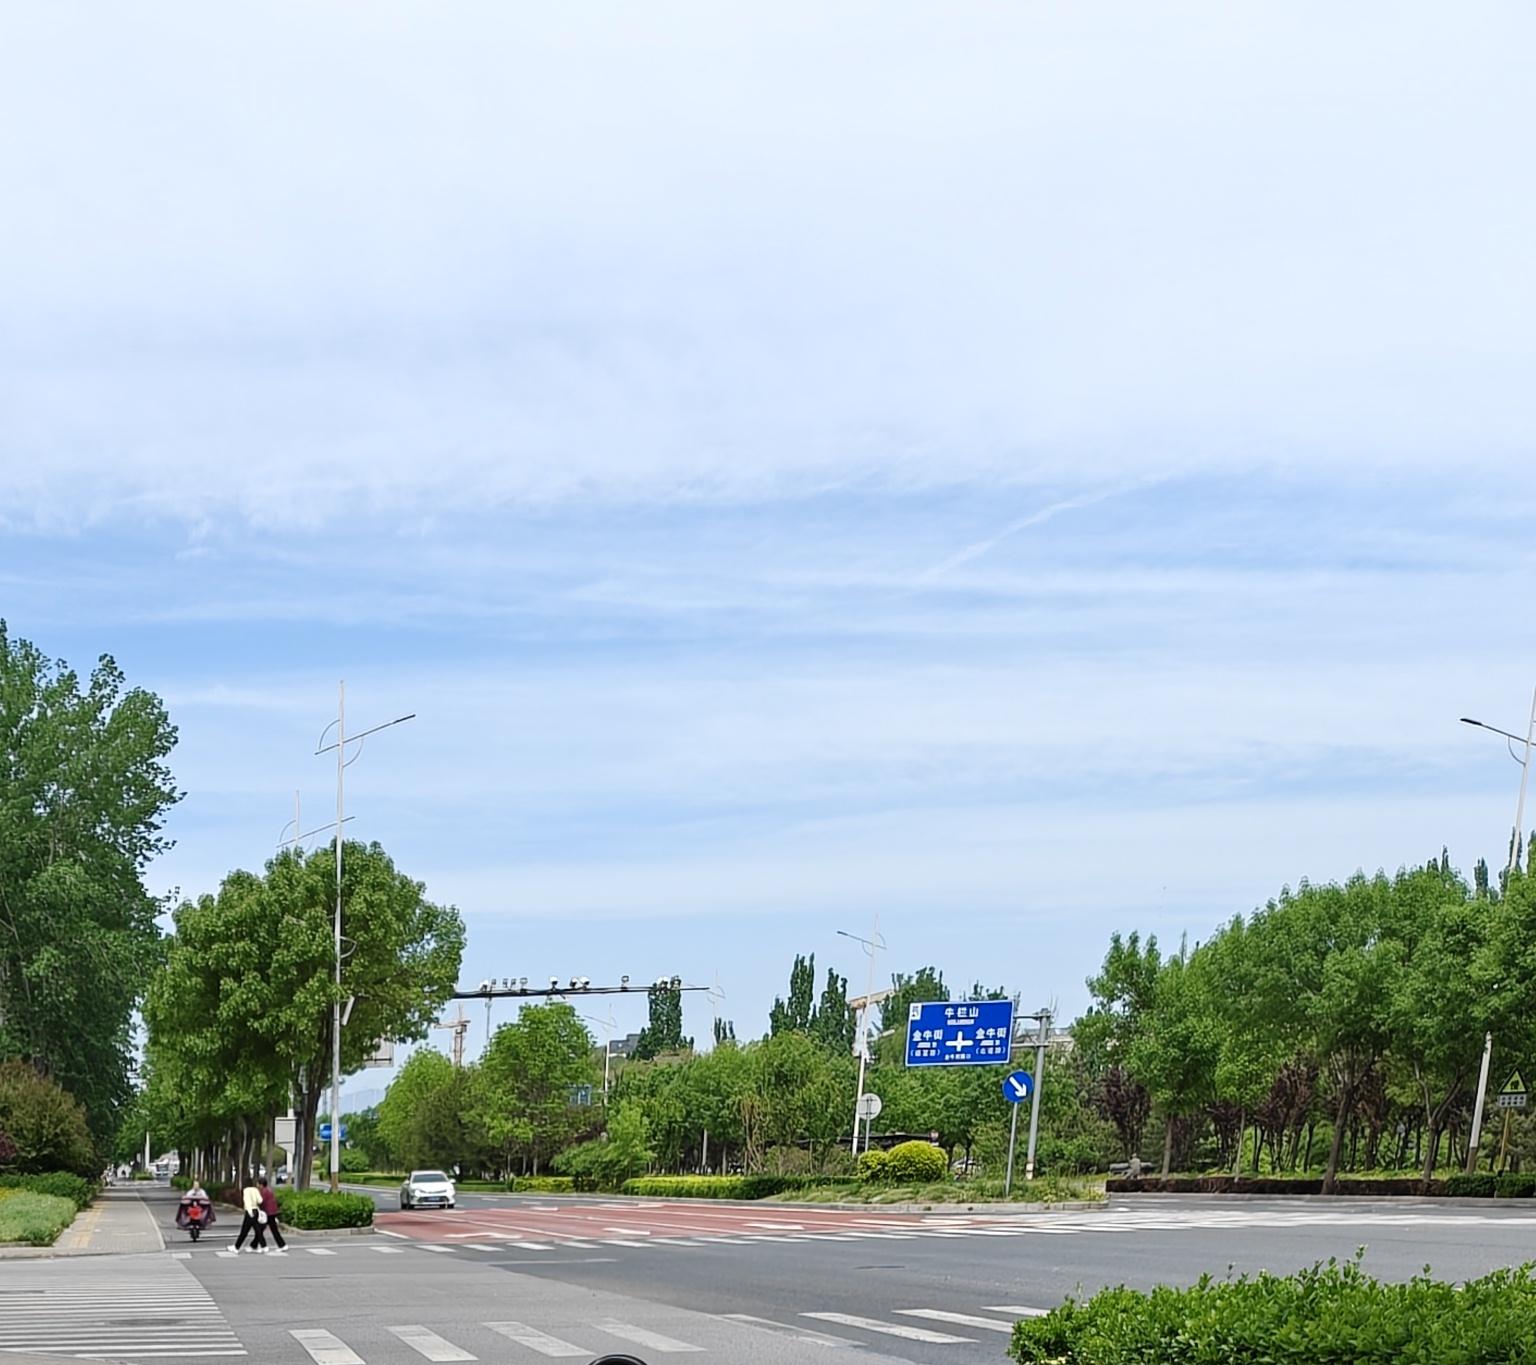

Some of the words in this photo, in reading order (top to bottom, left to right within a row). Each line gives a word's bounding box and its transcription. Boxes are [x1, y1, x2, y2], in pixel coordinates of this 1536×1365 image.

[945, 1006, 979, 1018] 牛栏山
[912, 1029, 943, 1041] 金牛街
[975, 1027, 1007, 1039] 金牛街
